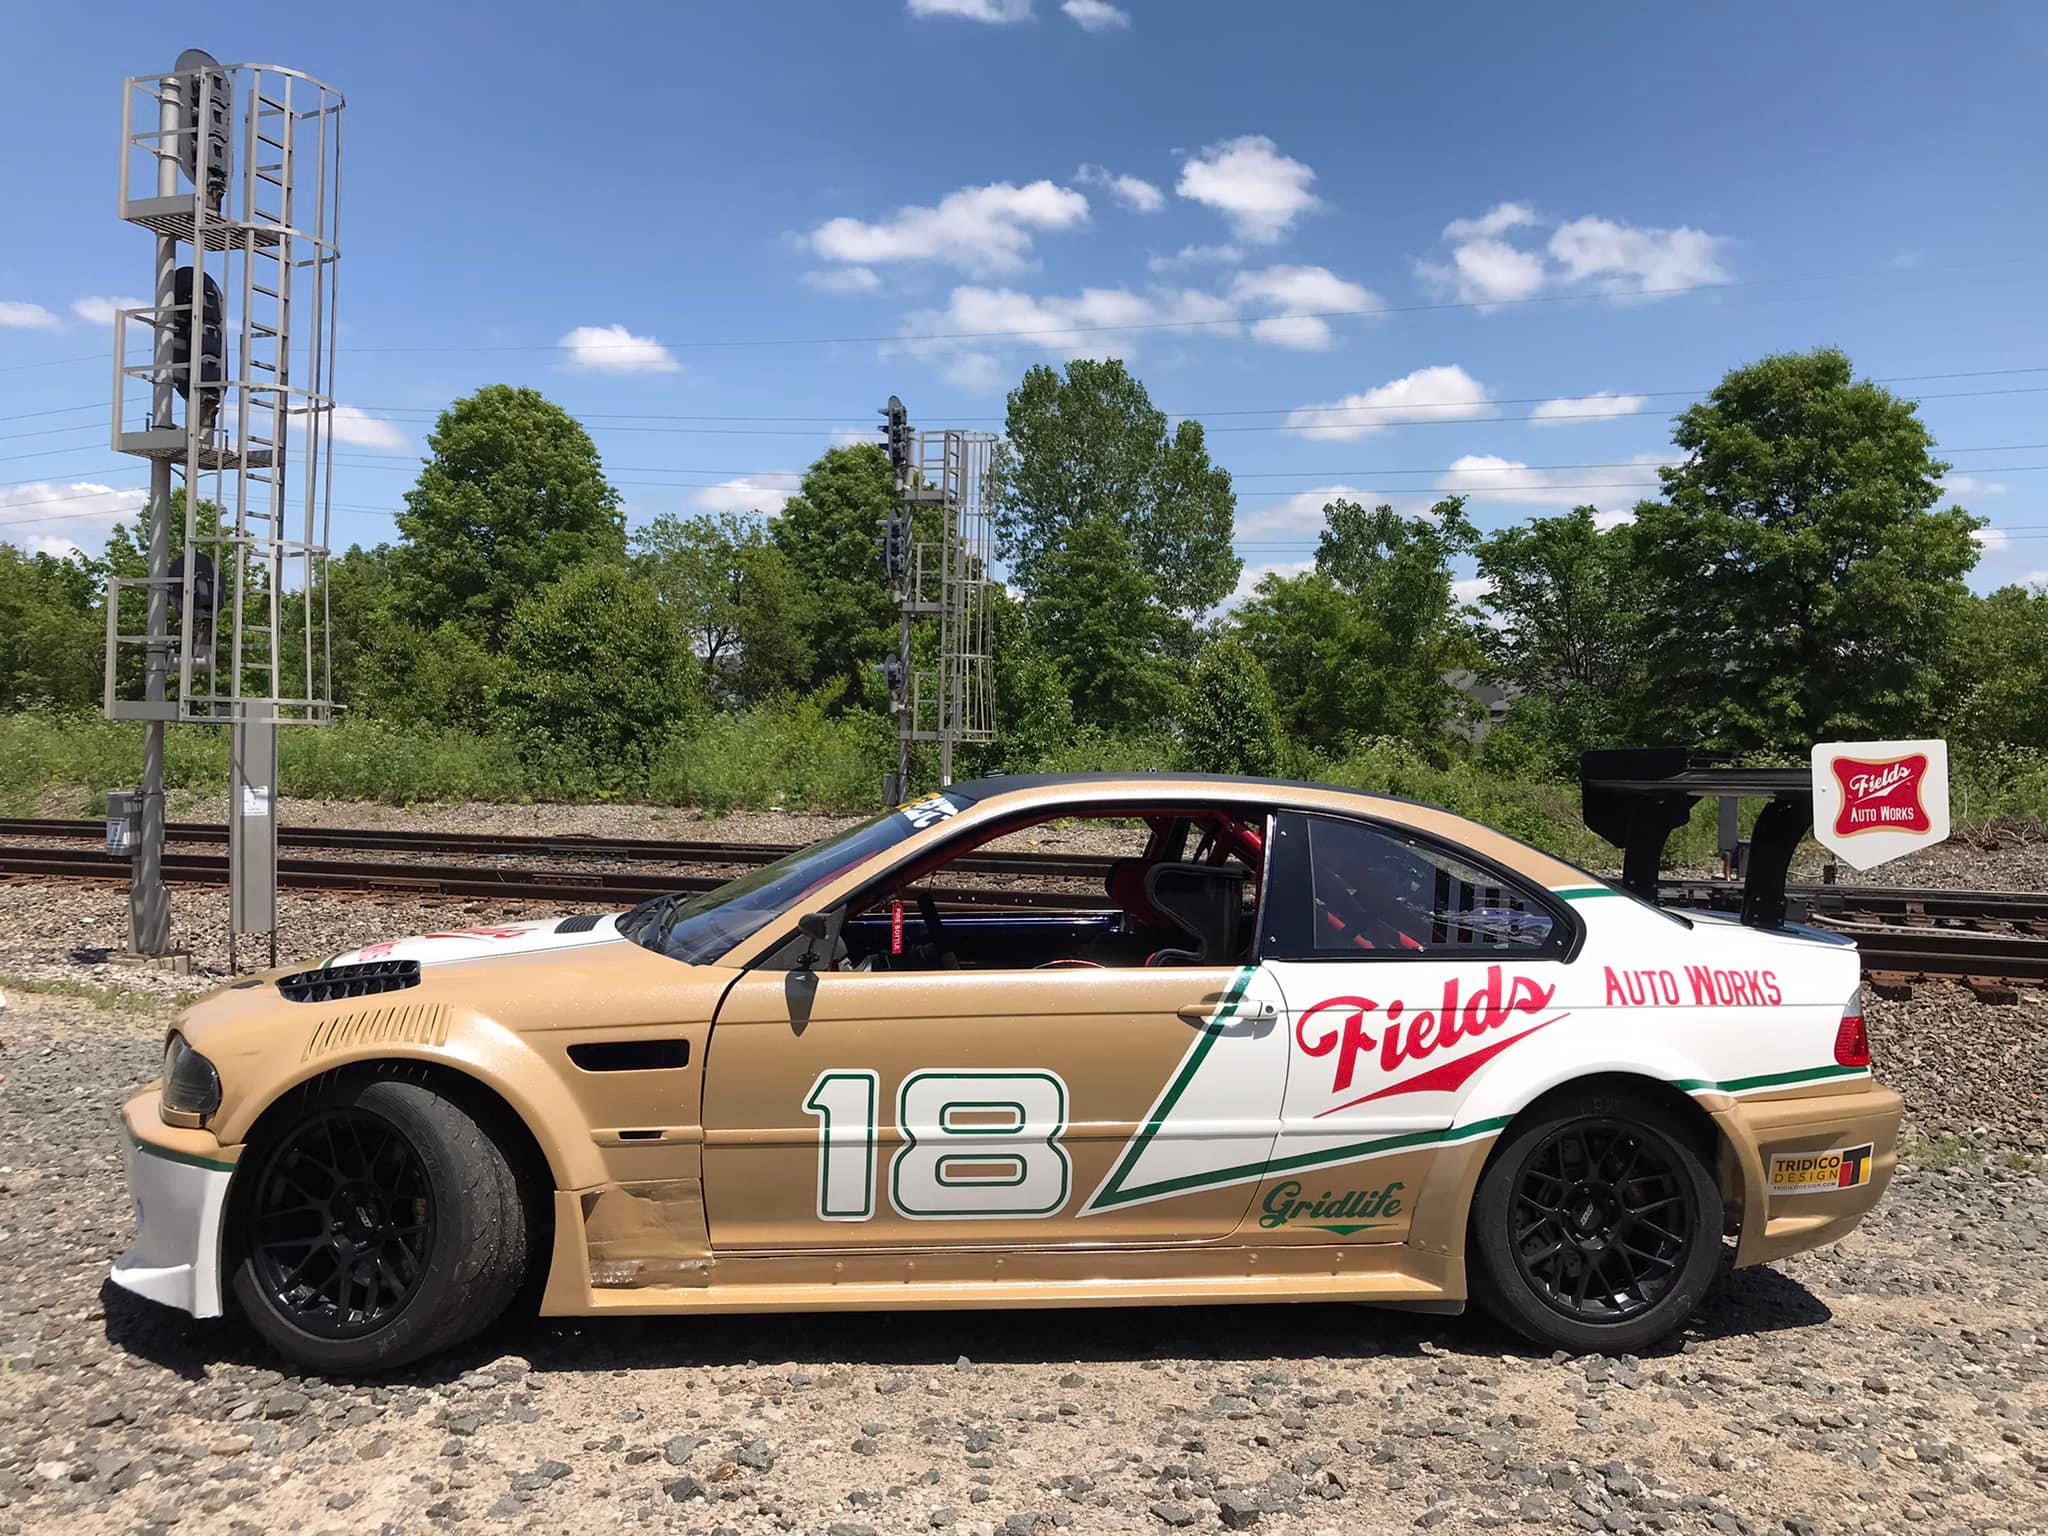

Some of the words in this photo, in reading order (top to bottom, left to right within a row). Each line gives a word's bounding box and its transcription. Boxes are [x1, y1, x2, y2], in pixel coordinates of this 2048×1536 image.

[1850, 763, 1911, 798] Fields
[1851, 807, 1877, 822] AUTO
[1880, 805, 1915, 821] WORKS
[1603, 965, 1680, 1006] AUTO
[1683, 965, 1783, 1006] WORKS
[1296, 965, 1556, 1094] Fields
[801, 1068, 1073, 1222] 18
[1775, 1156, 1840, 1172] TRIDICO
[1774, 1170, 1838, 1183] DESIGN
[1258, 1180, 1405, 1229] Gridlife
